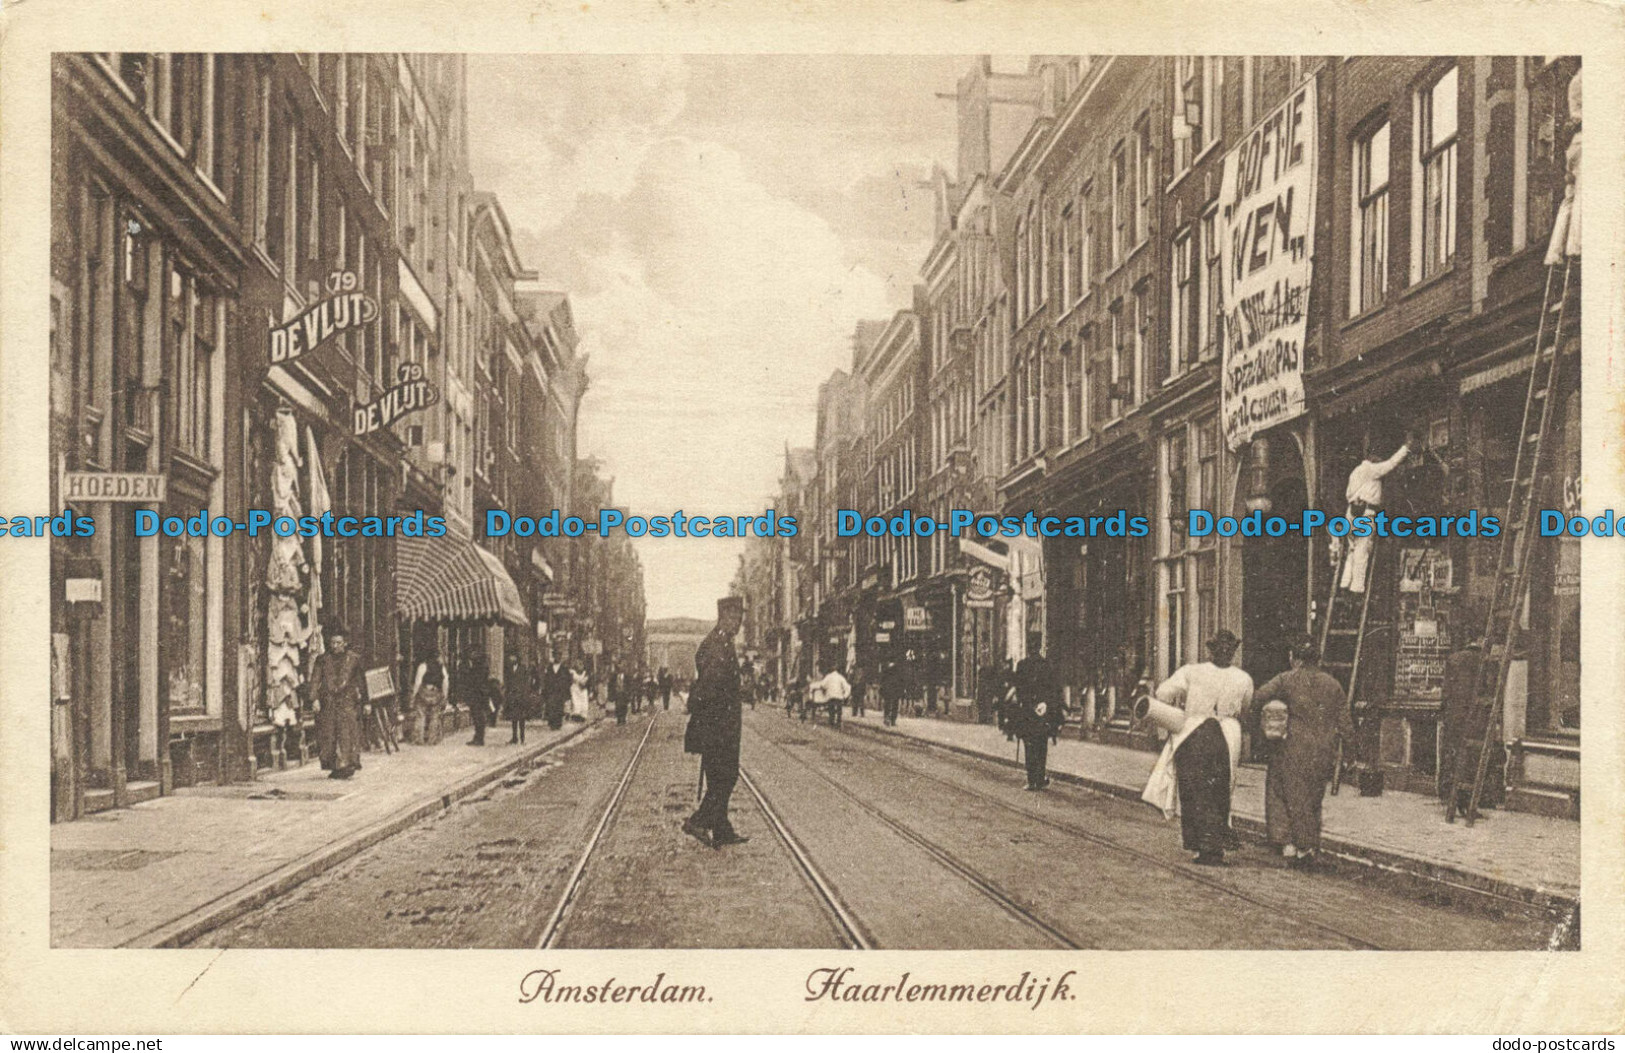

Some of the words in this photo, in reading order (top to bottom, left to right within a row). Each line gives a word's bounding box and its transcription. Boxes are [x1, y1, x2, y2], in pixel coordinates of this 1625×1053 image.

[331, 271, 357, 292] 79
[271, 320, 302, 363] DE
[400, 364, 423, 383] 79
[354, 402, 380, 436] DE
[67, 475, 161, 498] HOEDEN
